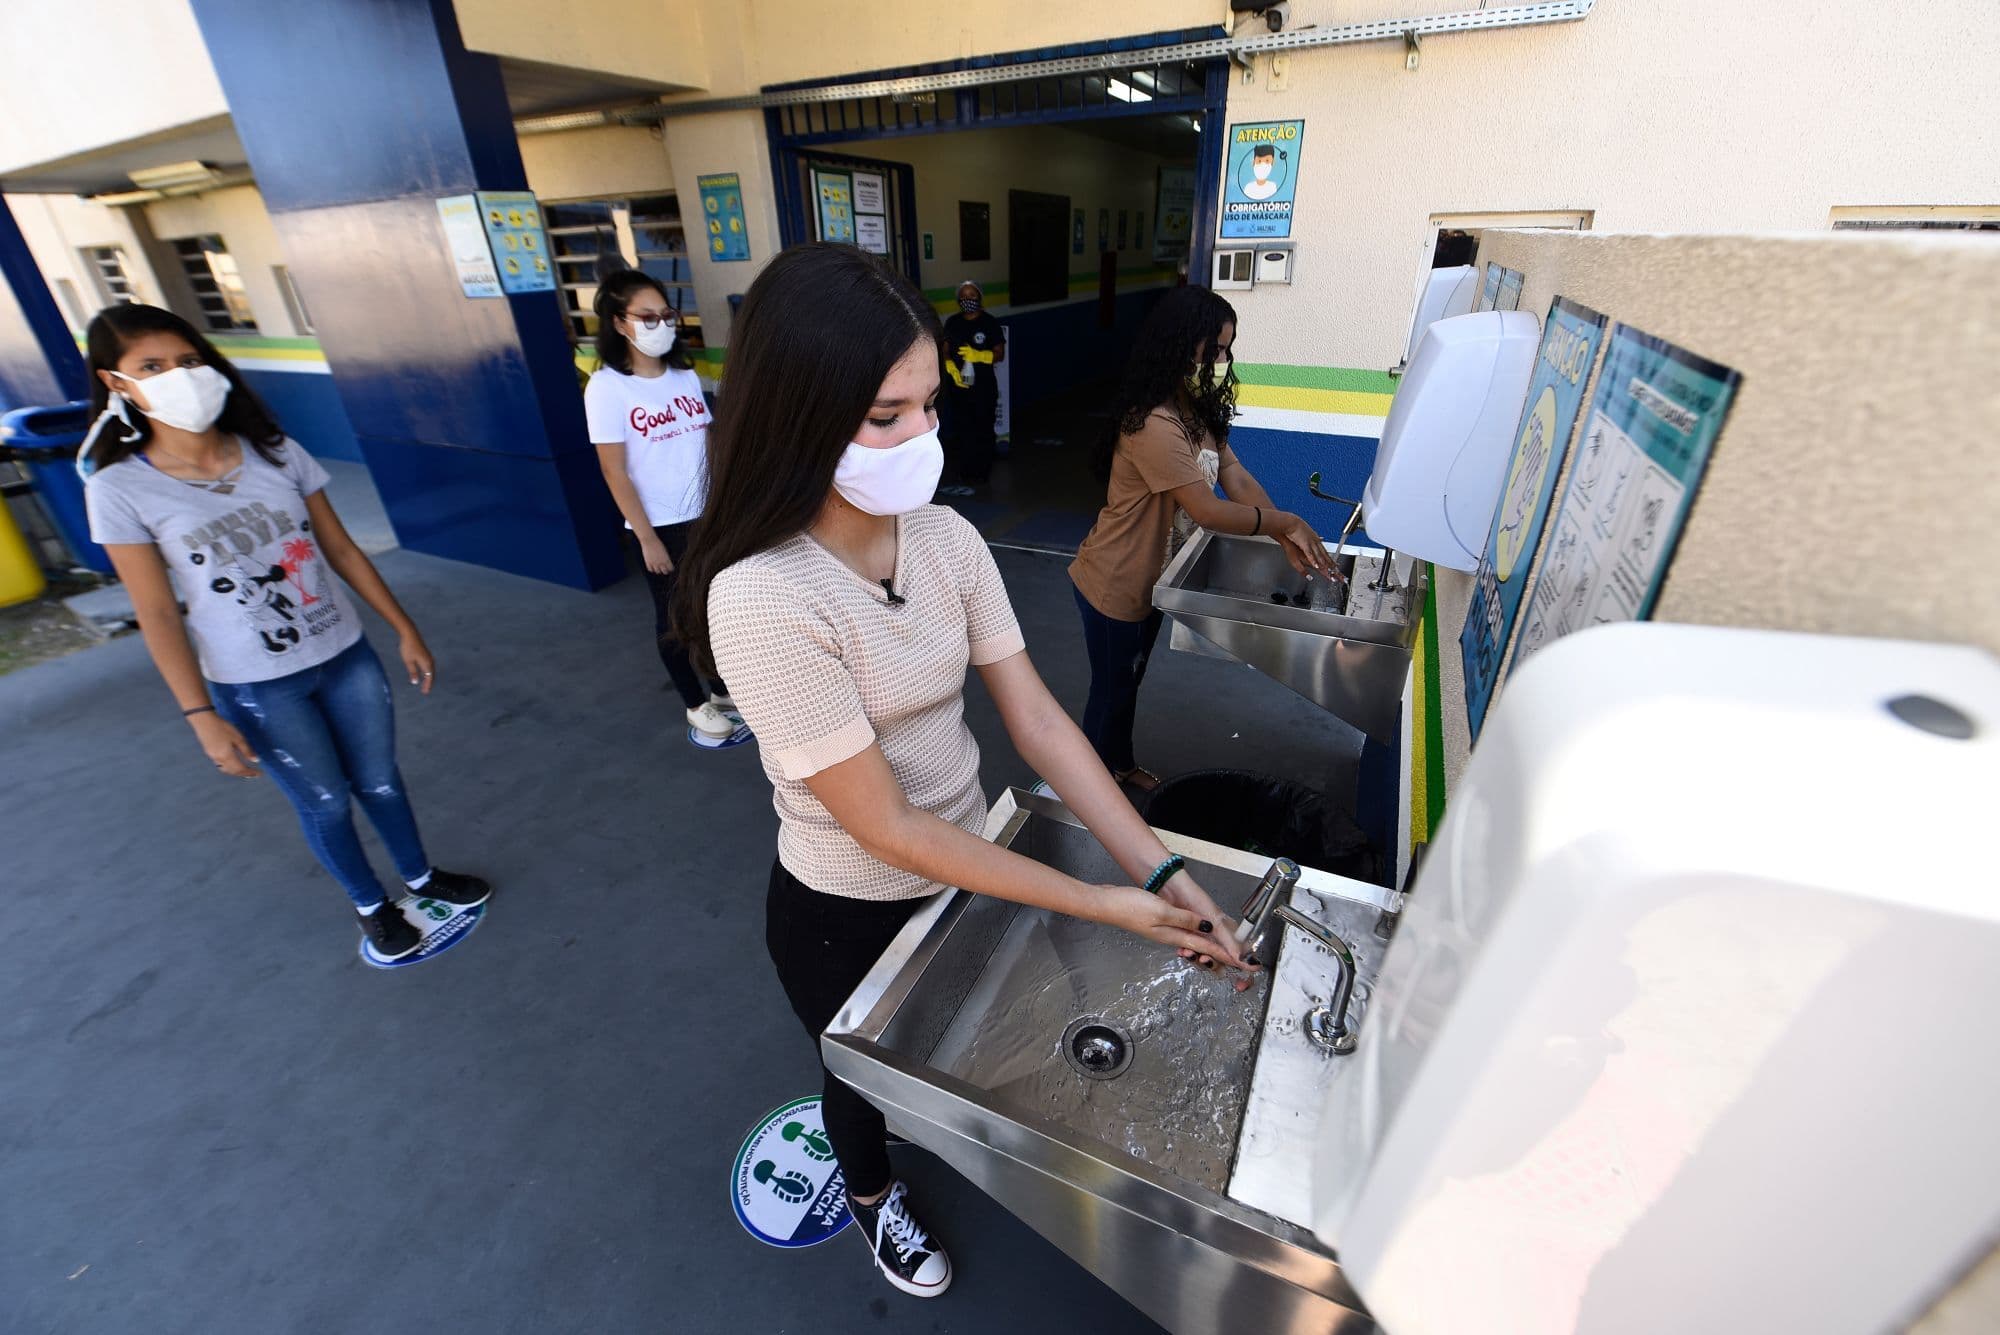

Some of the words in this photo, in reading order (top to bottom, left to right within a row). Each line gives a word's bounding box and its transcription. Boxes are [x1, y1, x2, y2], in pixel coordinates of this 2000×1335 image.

[1237, 124, 1296, 143] ATENÇÃO
[1224, 213, 1240, 221] USO
[1241, 213, 1251, 221] DE
[1251, 212, 1290, 221] MÁSCARA
[1225, 202, 1230, 213] É
[1230, 201, 1291, 213] OBRIGATÓRIO
[630, 404, 677, 437] Good
[211, 510, 294, 565] LOVE
[309, 613, 342, 635] MOUSE
[417, 913, 477, 956] MANTENHA
[772, 1103, 818, 1127] #PREVENÇÃO
[744, 1135, 763, 1165] MELHOR
[740, 1166, 750, 1205] PROTEÇÃO
